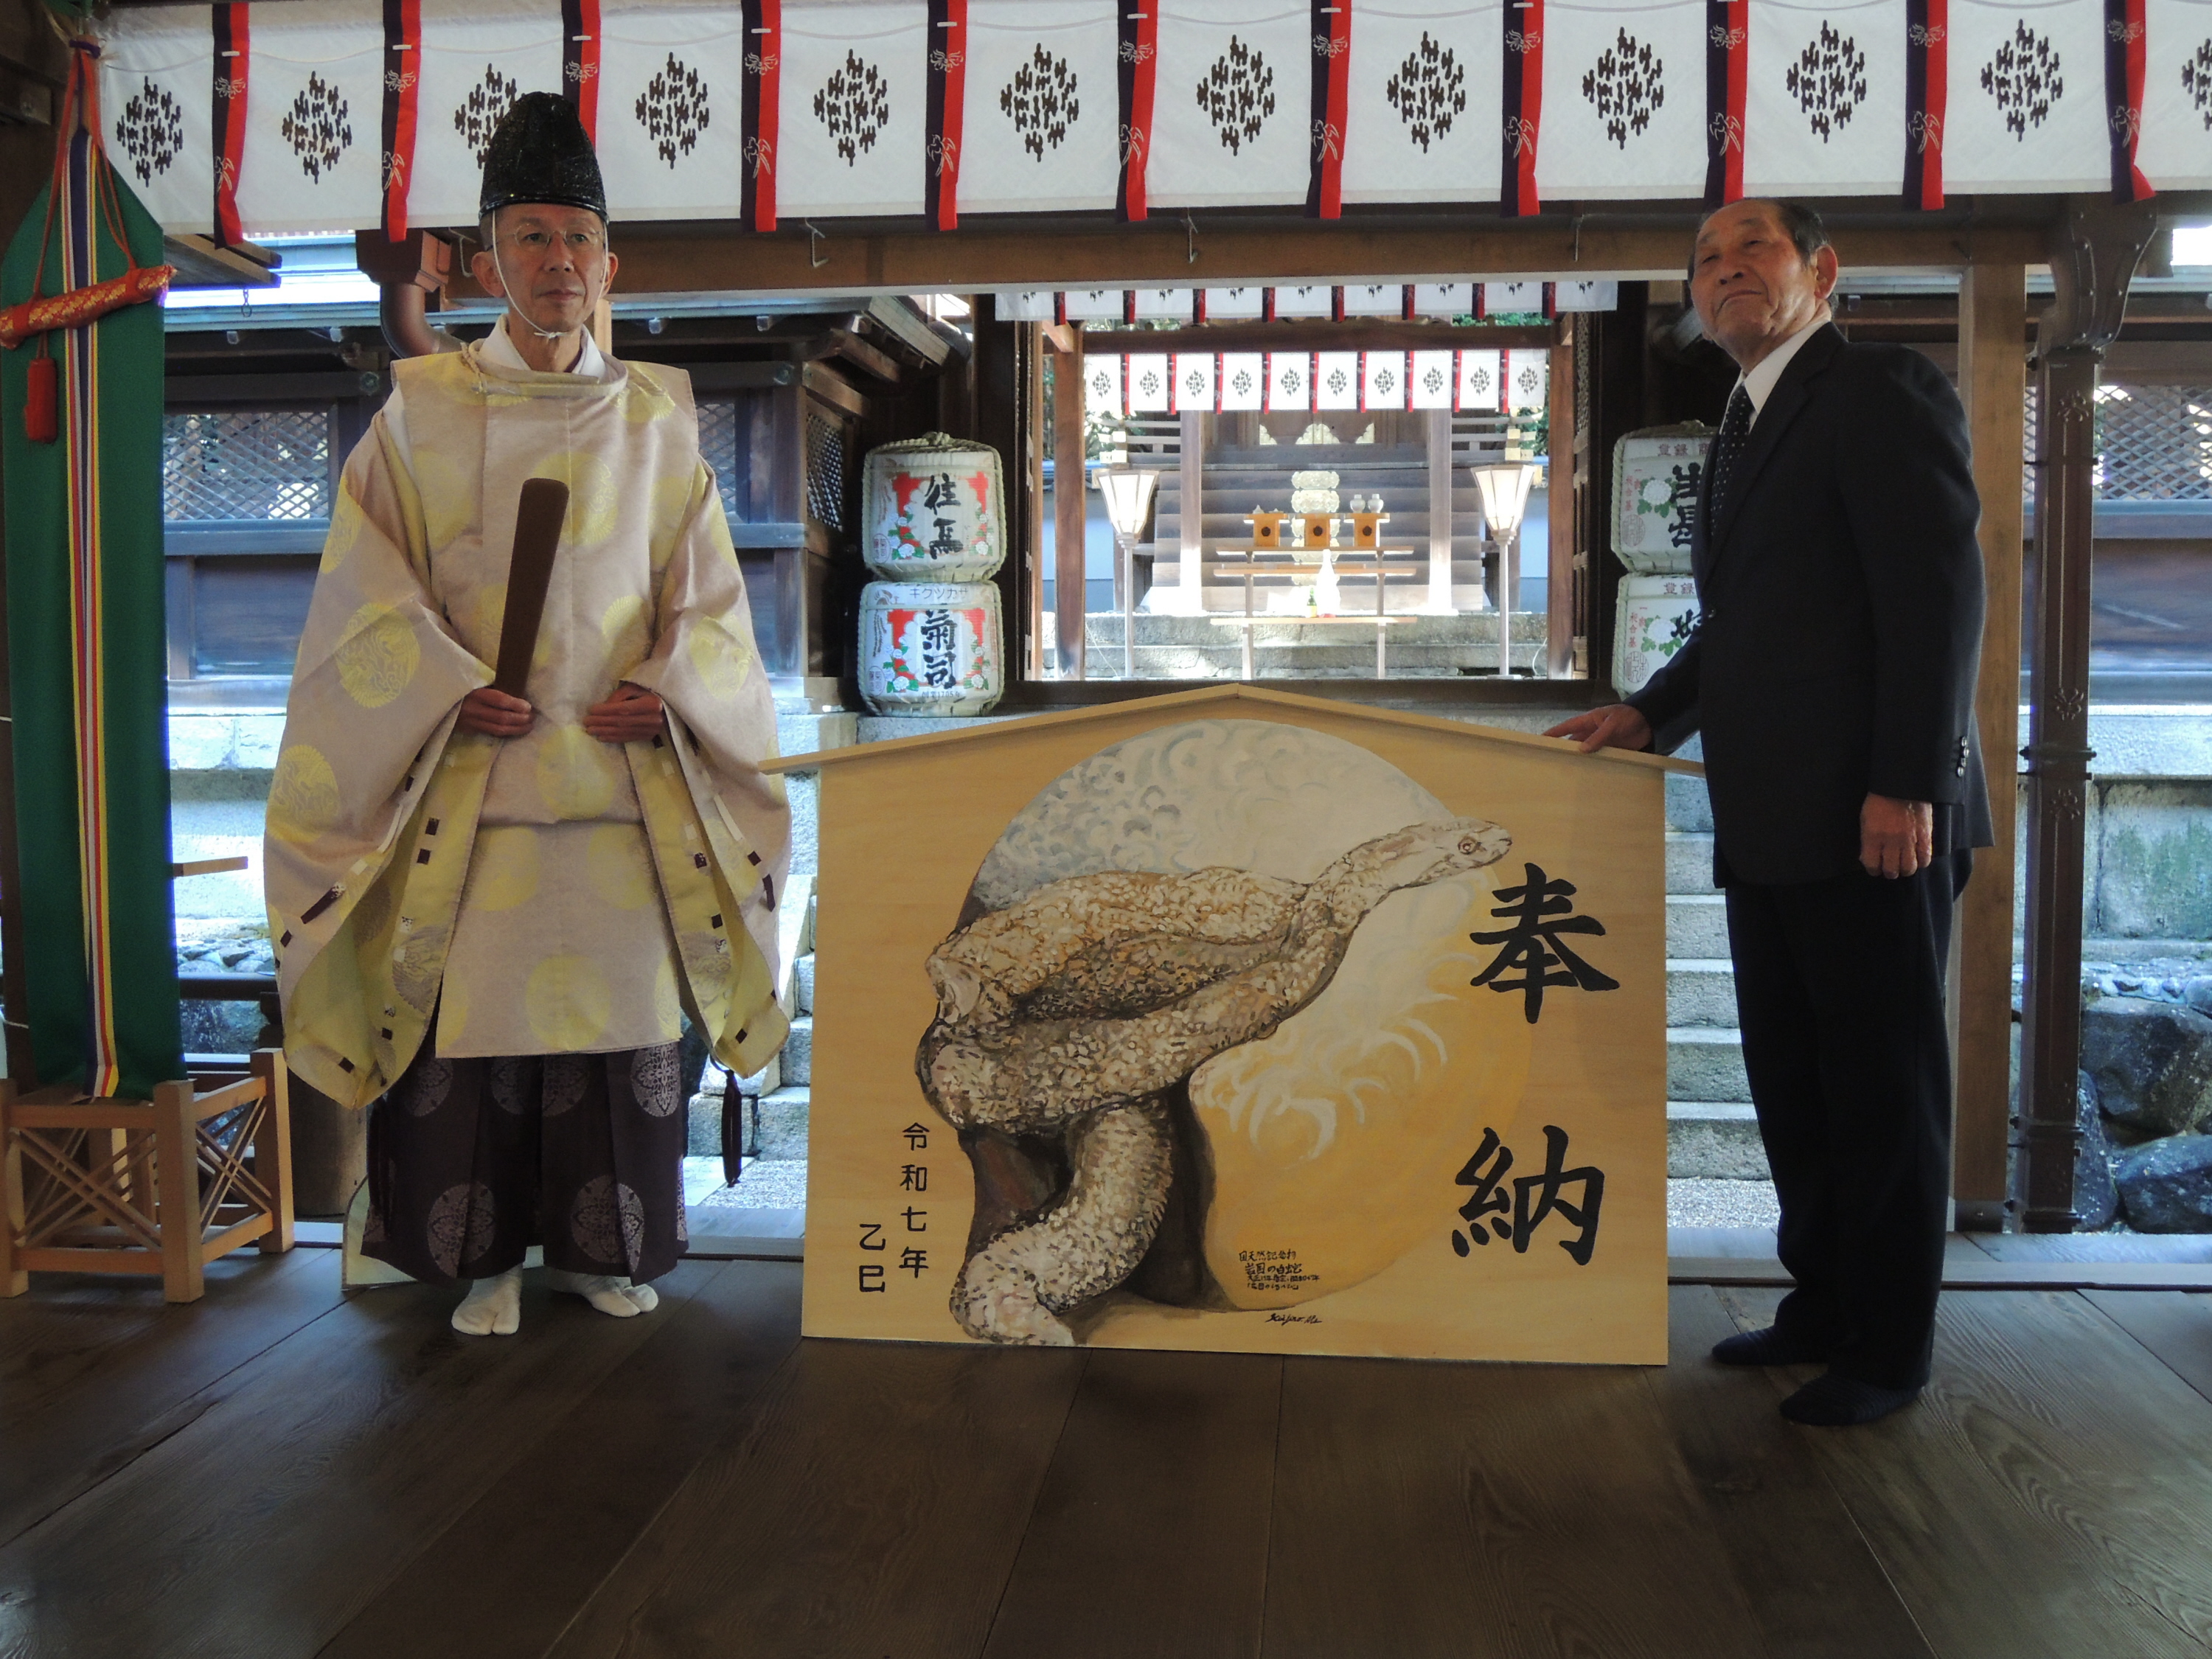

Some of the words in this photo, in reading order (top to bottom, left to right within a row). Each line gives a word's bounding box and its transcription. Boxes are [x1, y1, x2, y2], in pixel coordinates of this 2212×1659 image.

[920, 603, 957, 689] 菊司
[1451, 862, 1621, 1266] 奉納
[858, 1223, 886, 1293] 乙巳
[898, 1121, 930, 1279] 令和七年
